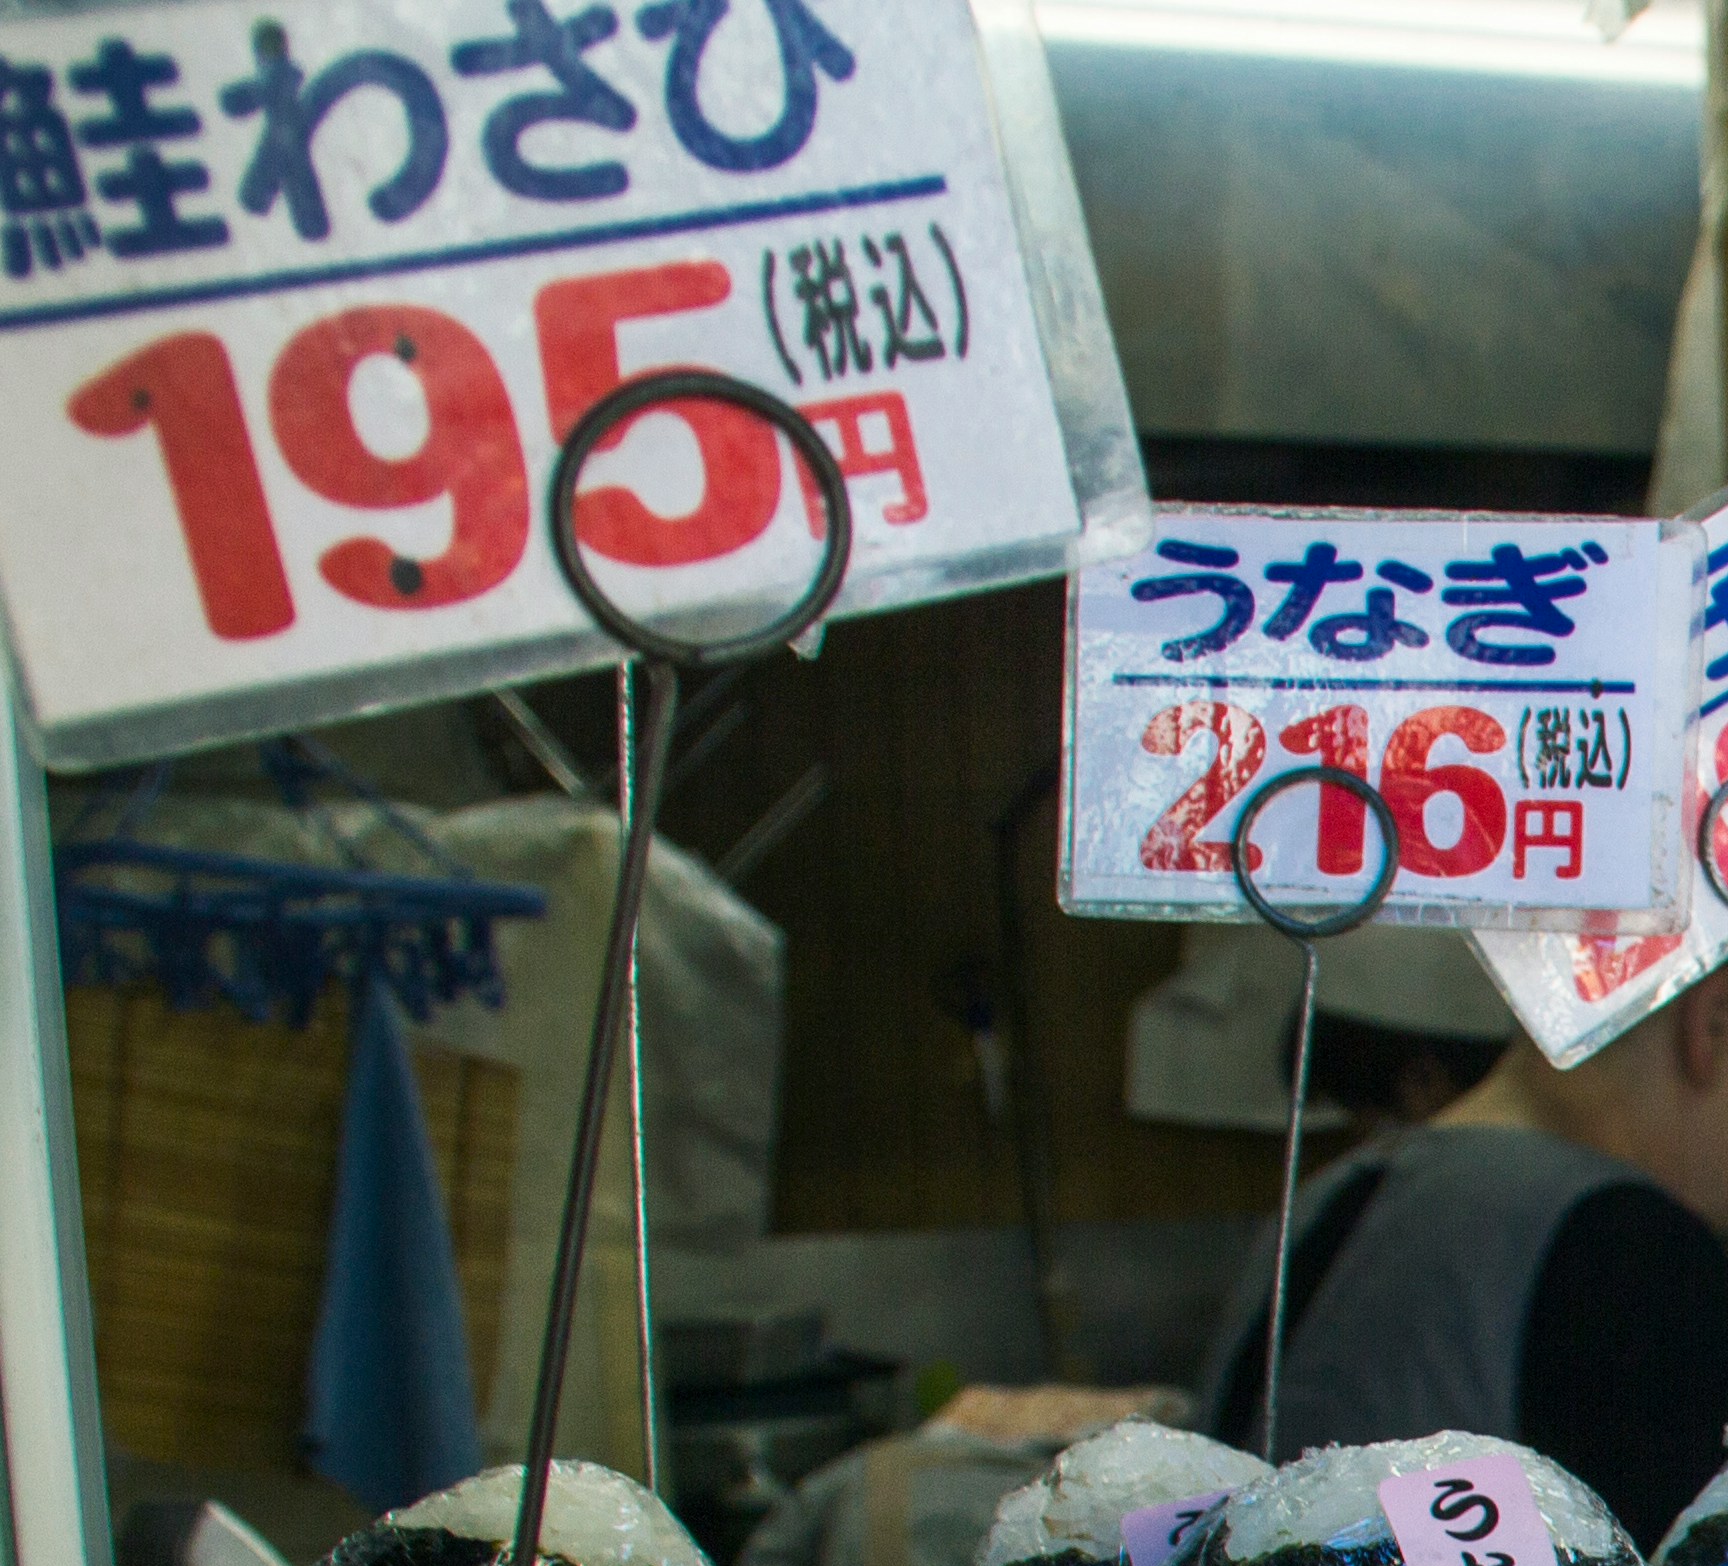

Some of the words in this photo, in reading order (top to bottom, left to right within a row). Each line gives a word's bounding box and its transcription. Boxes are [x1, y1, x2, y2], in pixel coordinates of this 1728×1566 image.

[1131, 541, 1609, 666] うなぎ
[1138, 699, 1584, 881] 216円
[1517, 706, 1632, 791] (税込)
